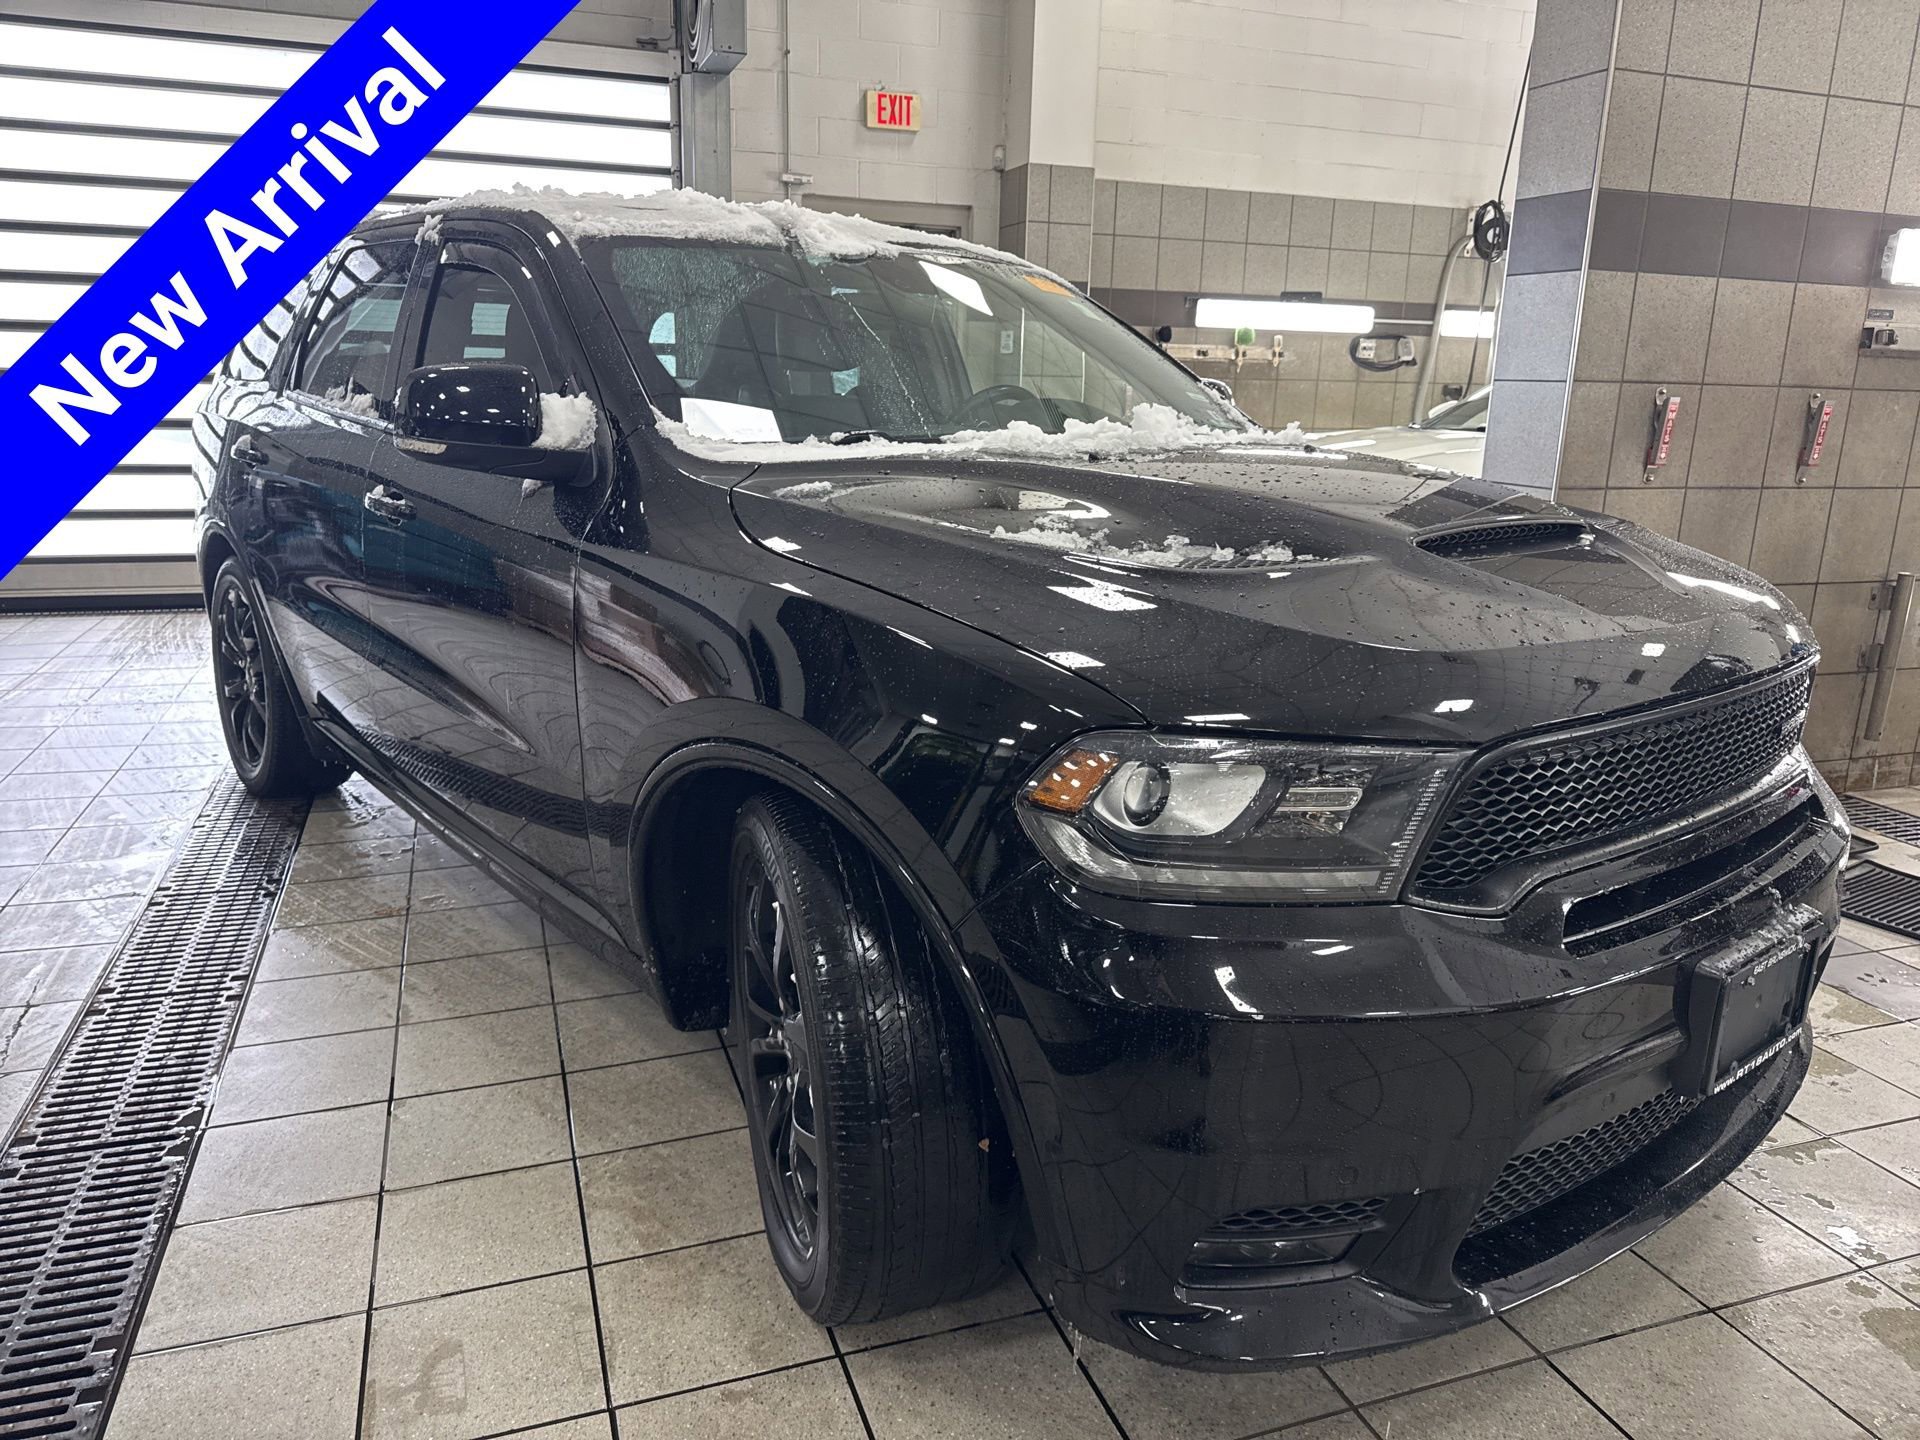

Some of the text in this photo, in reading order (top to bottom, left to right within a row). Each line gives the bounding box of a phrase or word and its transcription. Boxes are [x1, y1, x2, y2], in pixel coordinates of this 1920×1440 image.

[877, 93, 913, 126] EXIT
[1663, 412, 1677, 443] MATS
[1817, 414, 1830, 444] MATS
